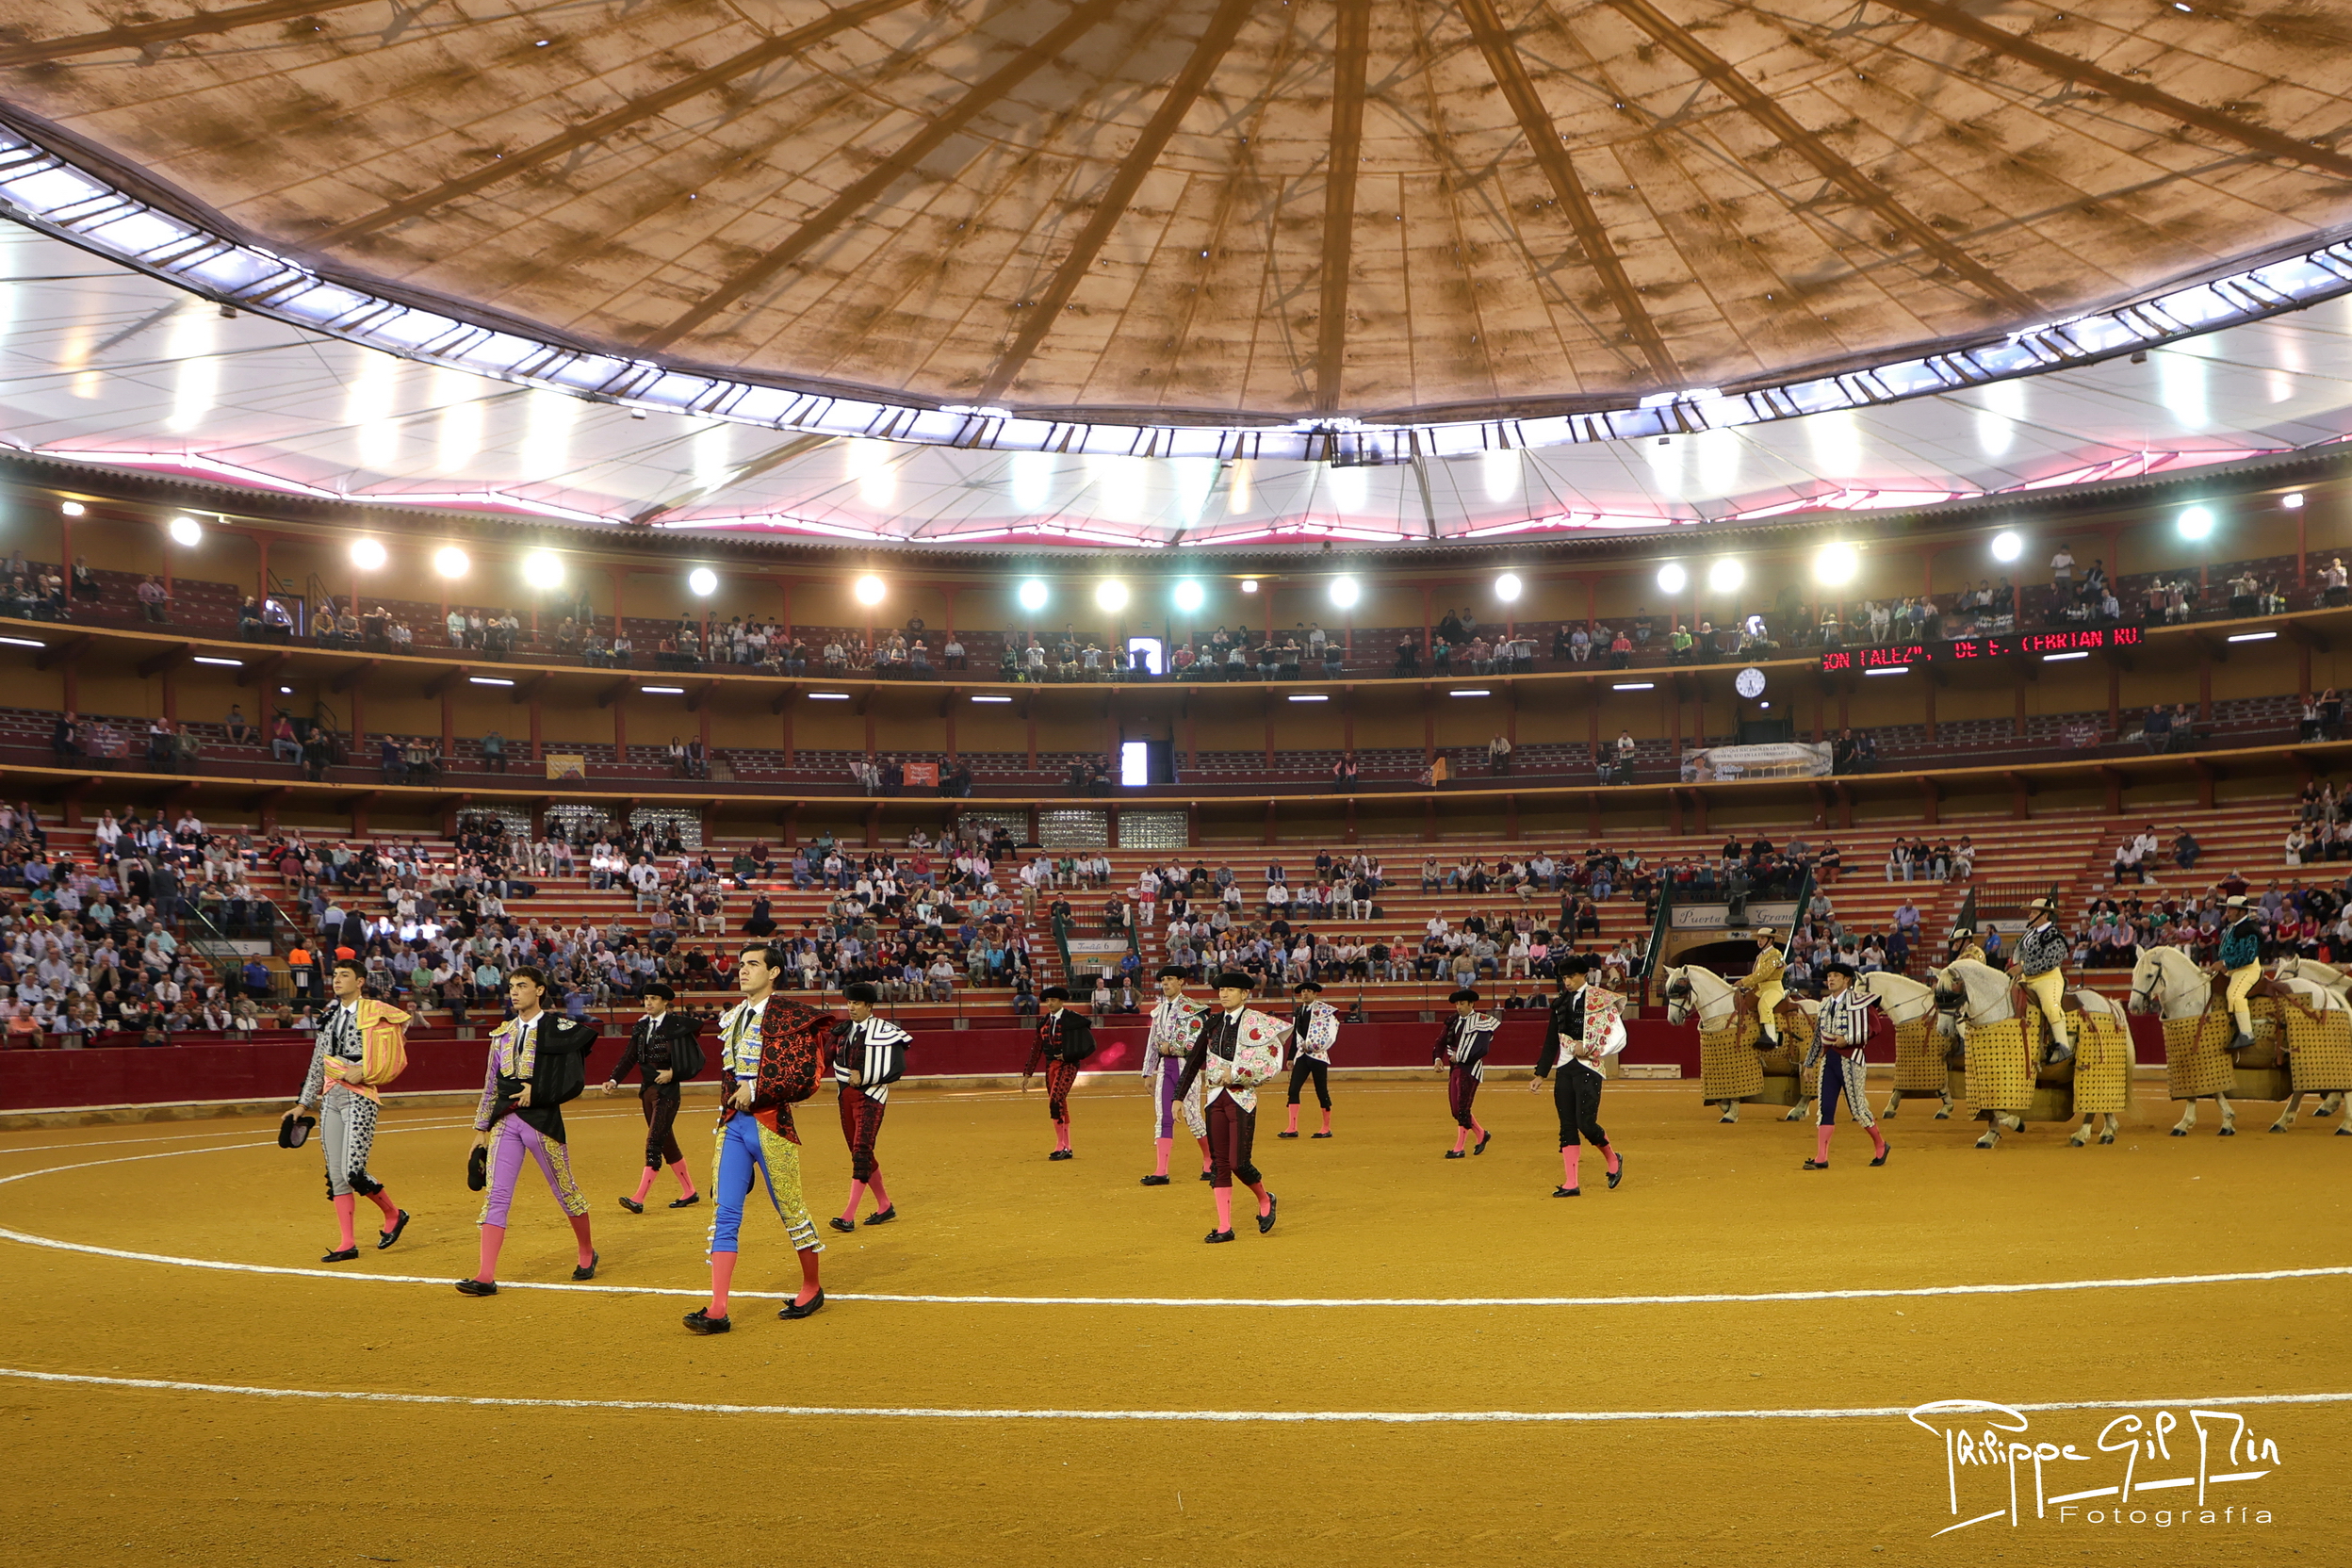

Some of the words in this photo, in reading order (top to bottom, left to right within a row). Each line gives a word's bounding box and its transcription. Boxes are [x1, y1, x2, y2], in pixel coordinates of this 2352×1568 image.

[1955, 642, 1978, 659] DE
[1679, 908, 1722, 923] Puerta
[1756, 908, 1797, 923] Grand
[243, 943, 249, 953] 5
[1103, 941, 1109, 950] 6
